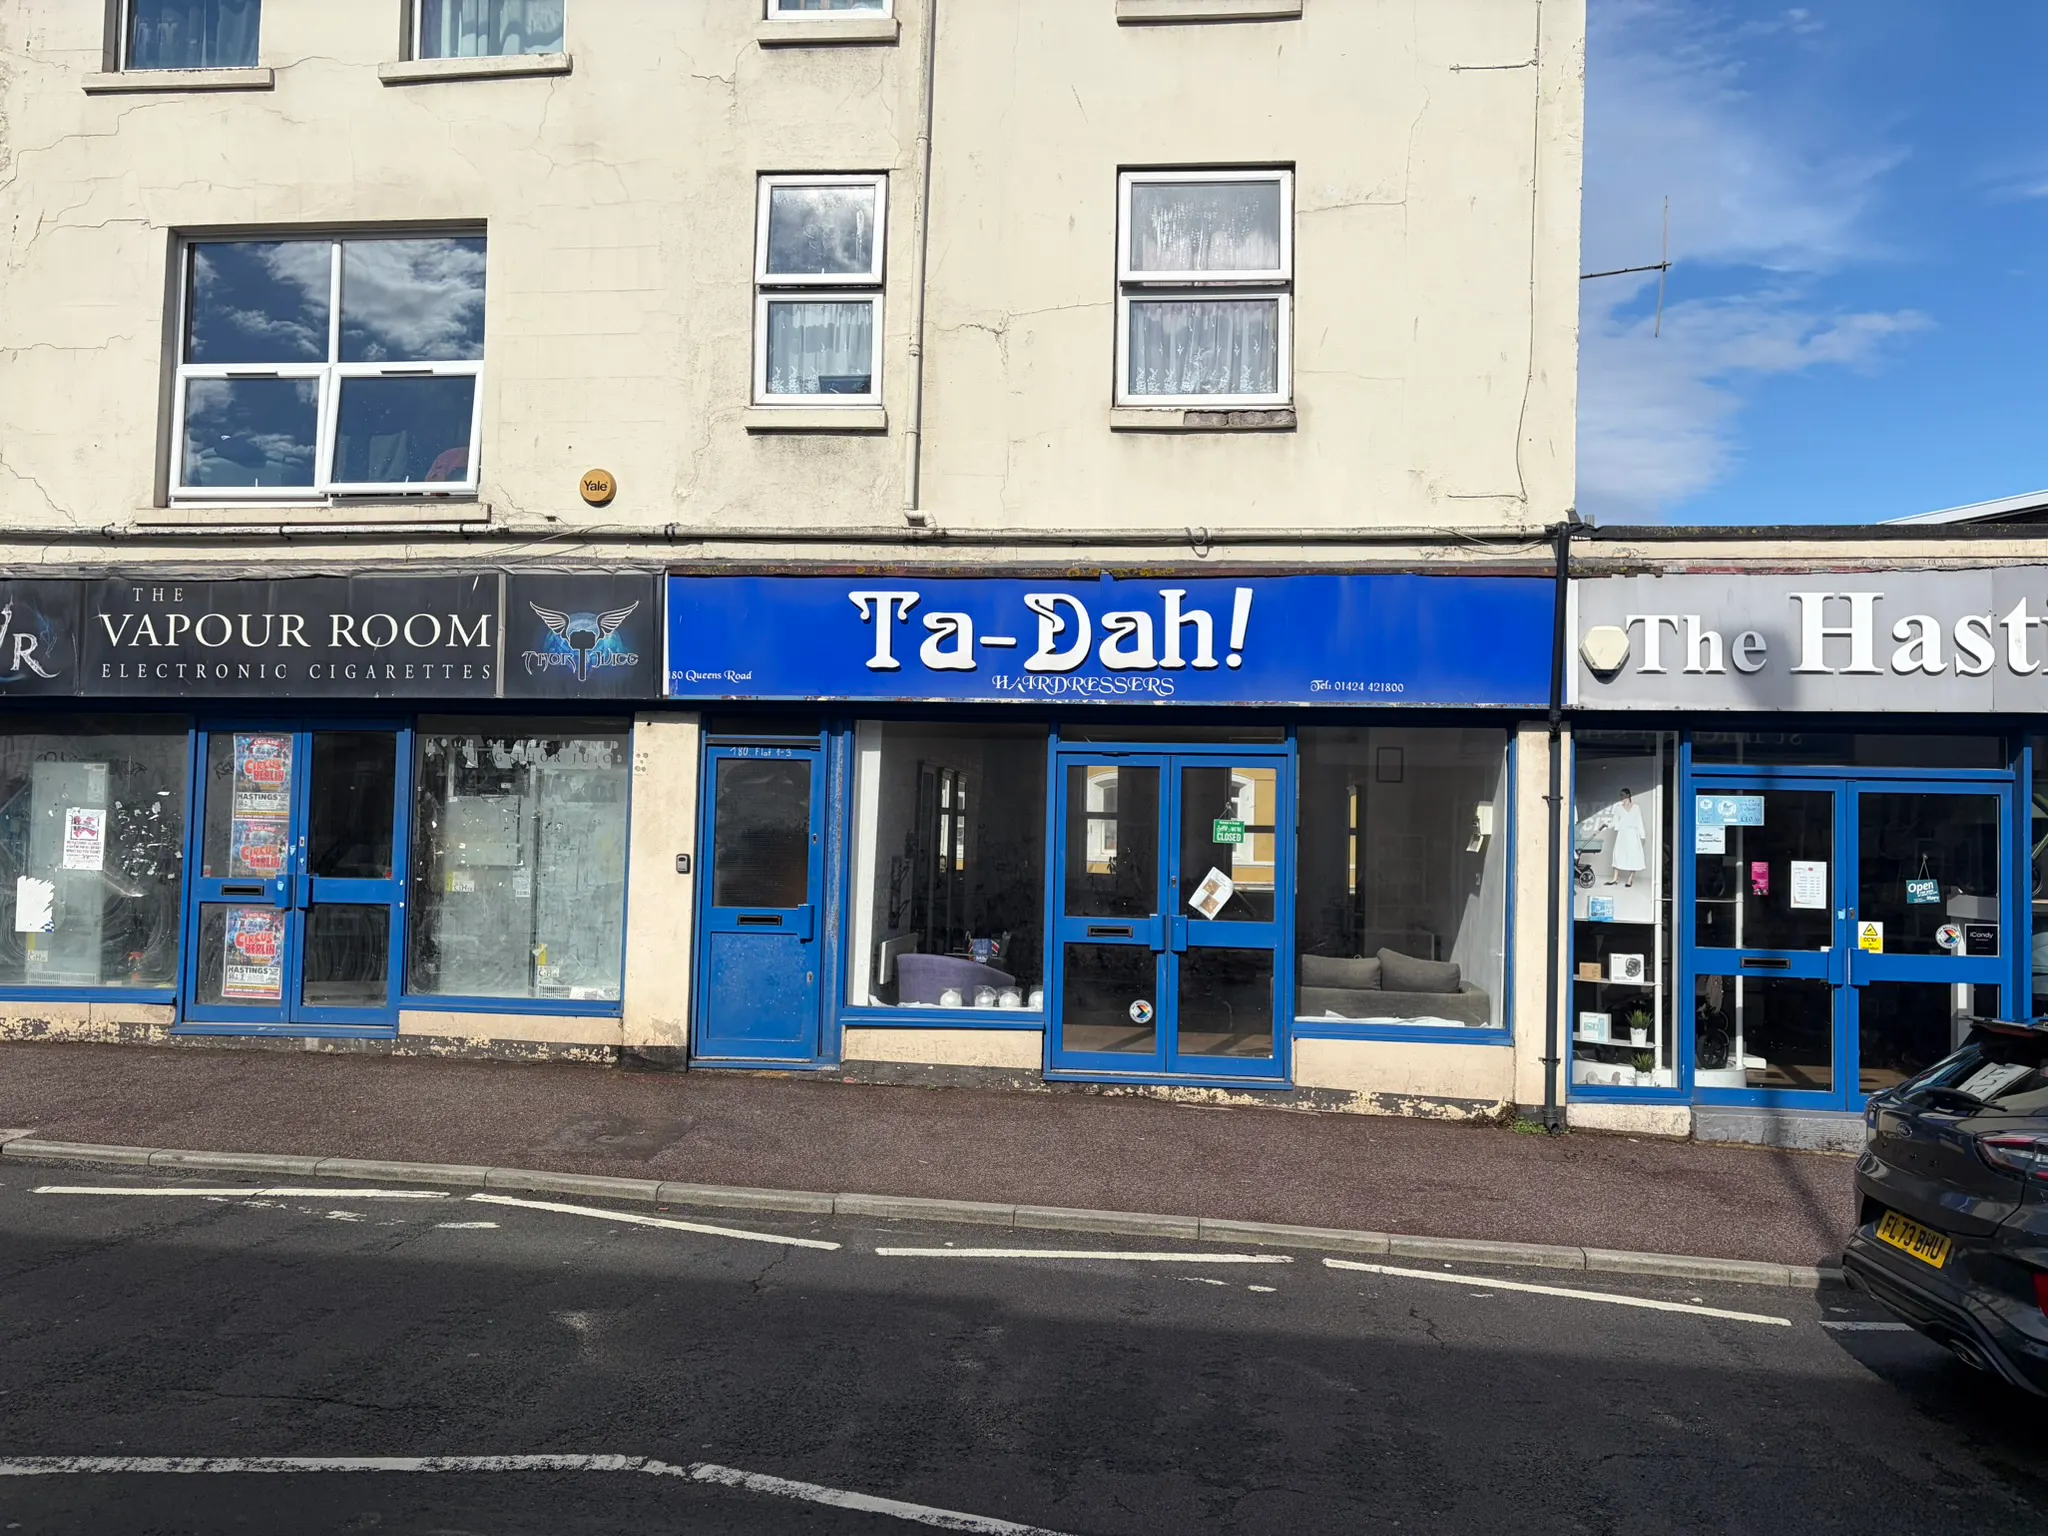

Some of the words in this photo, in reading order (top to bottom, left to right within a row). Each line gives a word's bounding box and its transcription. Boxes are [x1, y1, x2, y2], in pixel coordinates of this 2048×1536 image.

[584, 480, 608, 492] Yale
[132, 587, 184, 602] THE
[99, 613, 312, 648] VAPOUR
[327, 613, 492, 649] ROOM
[848, 587, 1254, 673] Ta-Dah!
[1626, 614, 1768, 674] The
[1789, 592, 2048, 676] Hast
[101, 662, 288, 679] ELECTRONIC
[309, 663, 492, 680] CIGARETTES
[685, 669, 722, 683] Queens
[723, 669, 753, 684] Road
[992, 675, 1175, 696] HAIRDRESSERS
[1310, 680, 1332, 692] Tel:
[1334, 681, 1364, 691] 01424
[1367, 682, 1405, 692] 421800
[755, 748, 772, 757] Flat
[776, 748, 793, 757] 1-3
[237, 793, 278, 801] HASTINGS
[1216, 833, 1242, 841] CLOSED
[1907, 881, 1934, 895] Open
[236, 932, 274, 948] CIRCUS
[245, 944, 276, 955] BERLIN
[228, 966, 269, 974] HASTINGS
